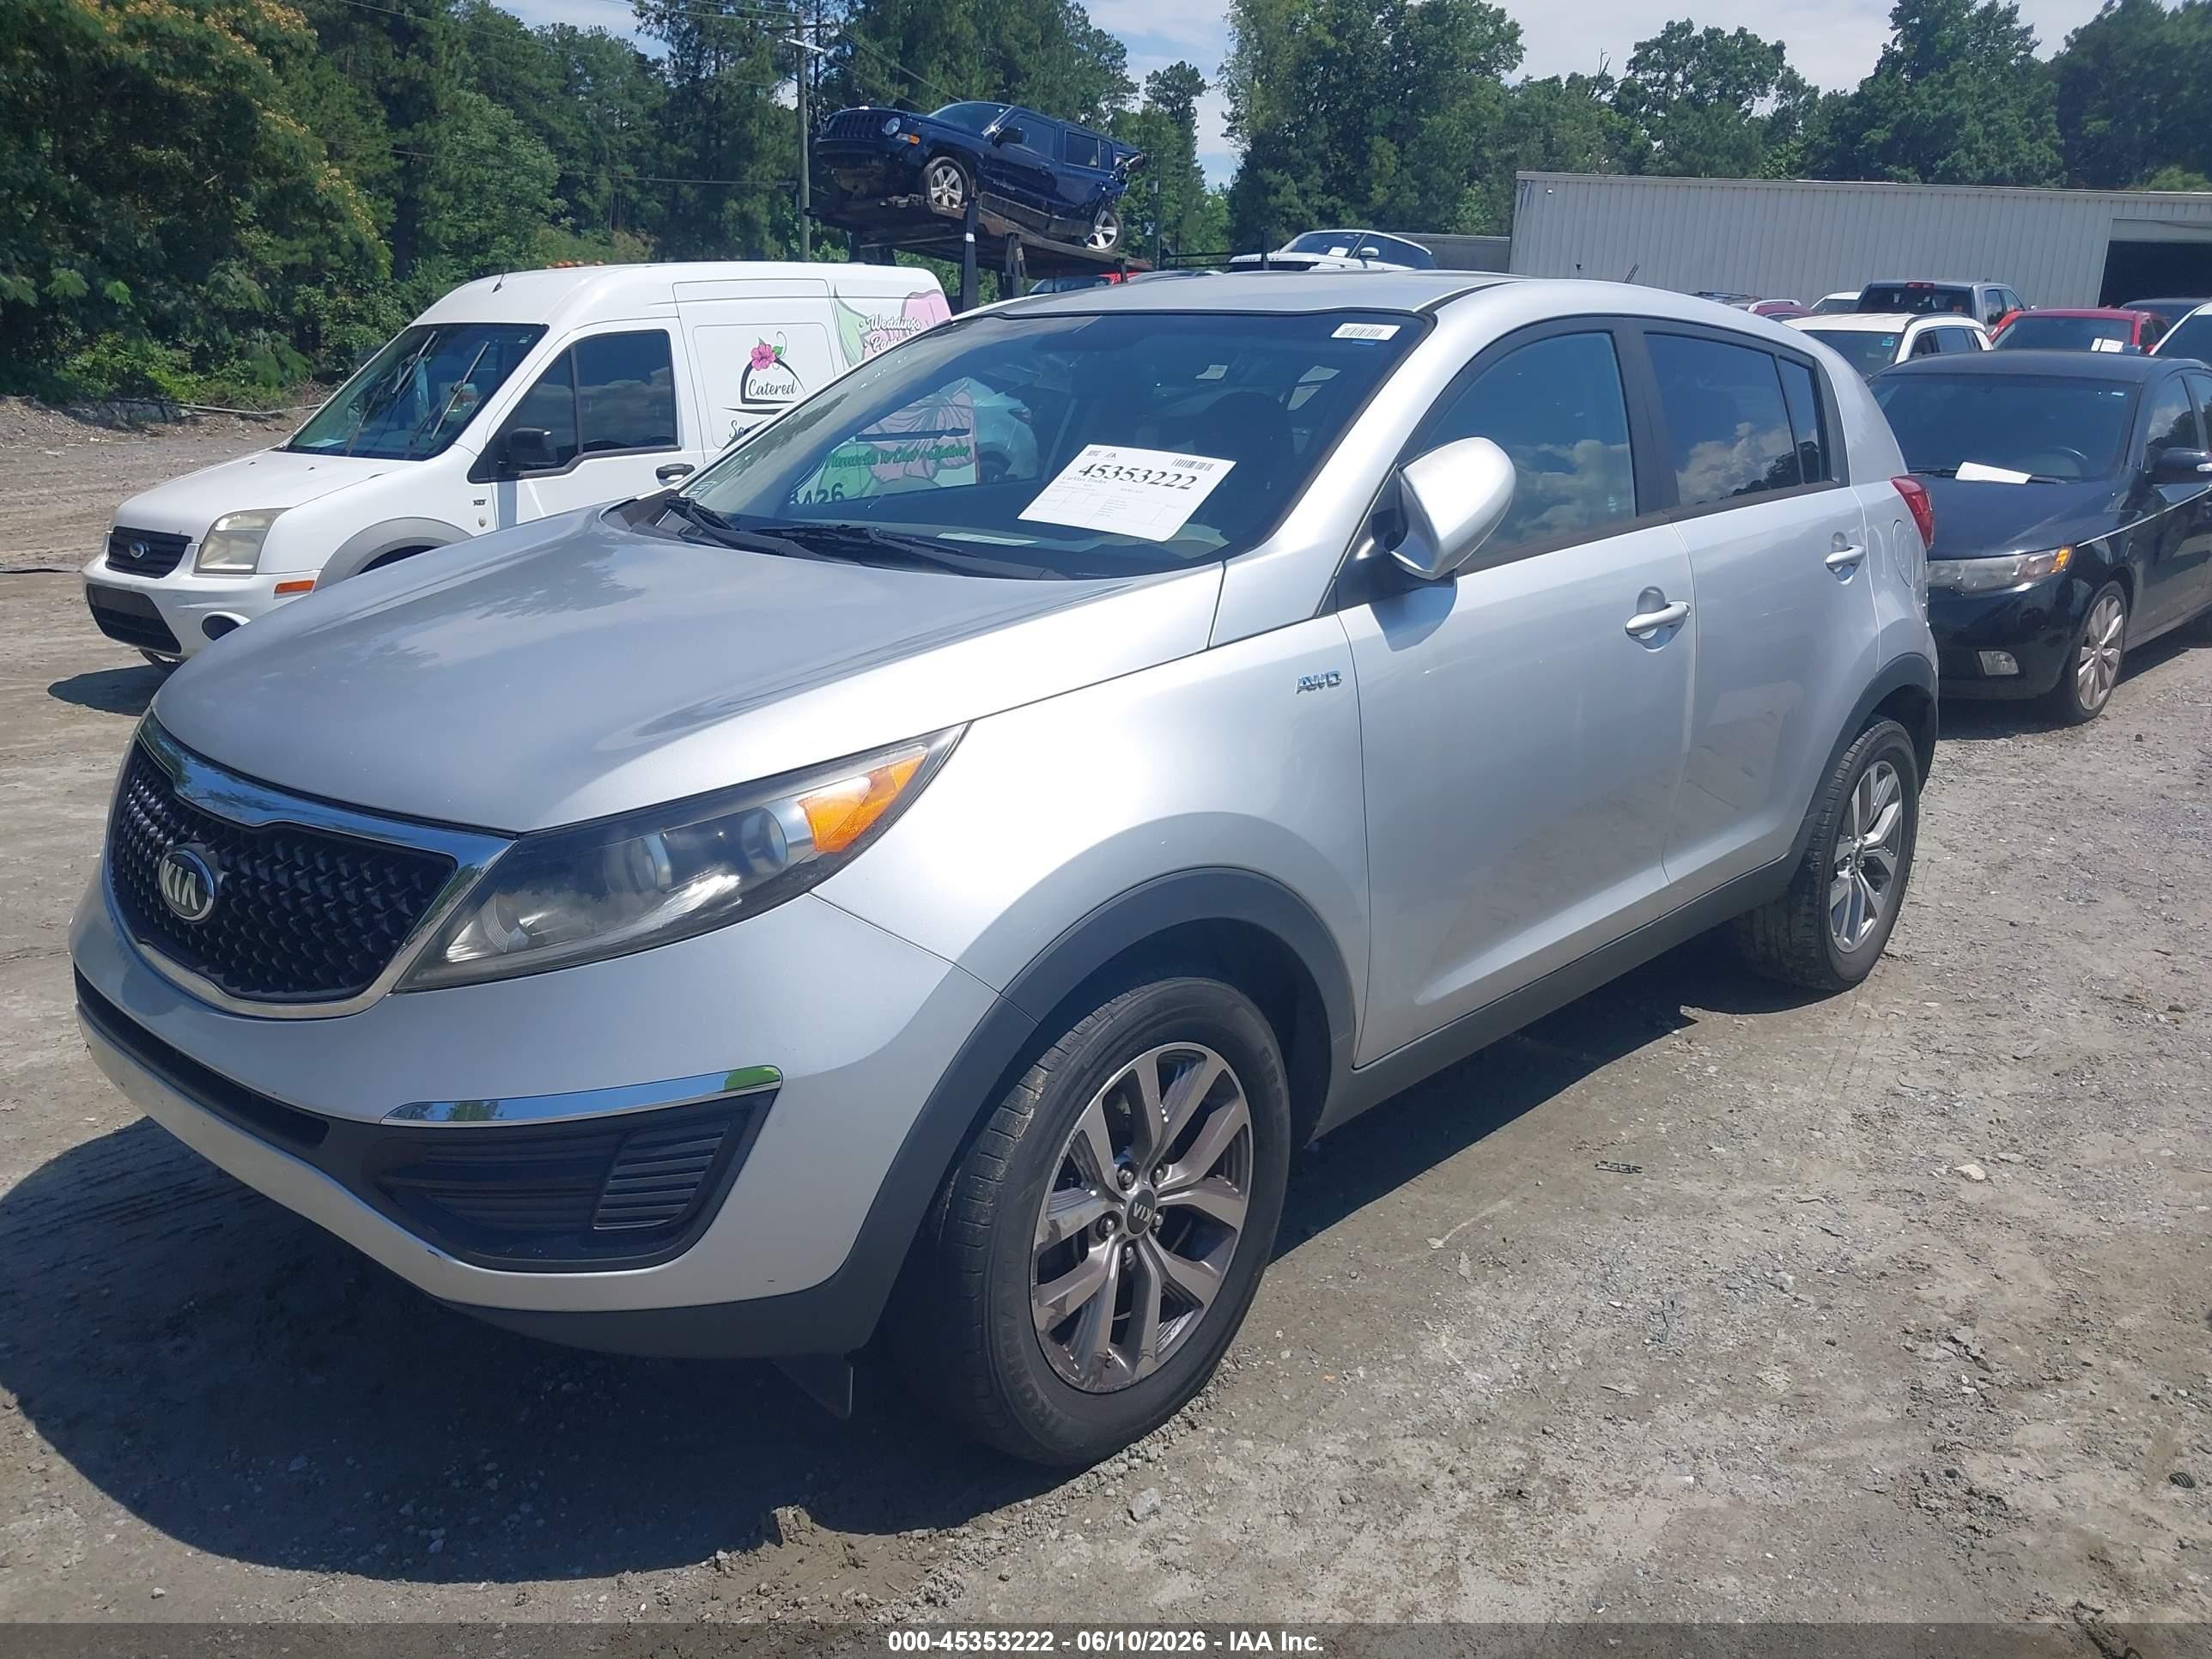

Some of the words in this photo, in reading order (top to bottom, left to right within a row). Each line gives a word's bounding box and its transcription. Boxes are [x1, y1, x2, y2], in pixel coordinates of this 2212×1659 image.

[866, 314, 921, 335] Weddings
[748, 379, 798, 397] Catered
[1078, 463, 1197, 490] 45353222
[1295, 671, 1342, 694] AWD
[162, 859, 198, 910] KIA
[1133, 1202, 1154, 1224] KIA
